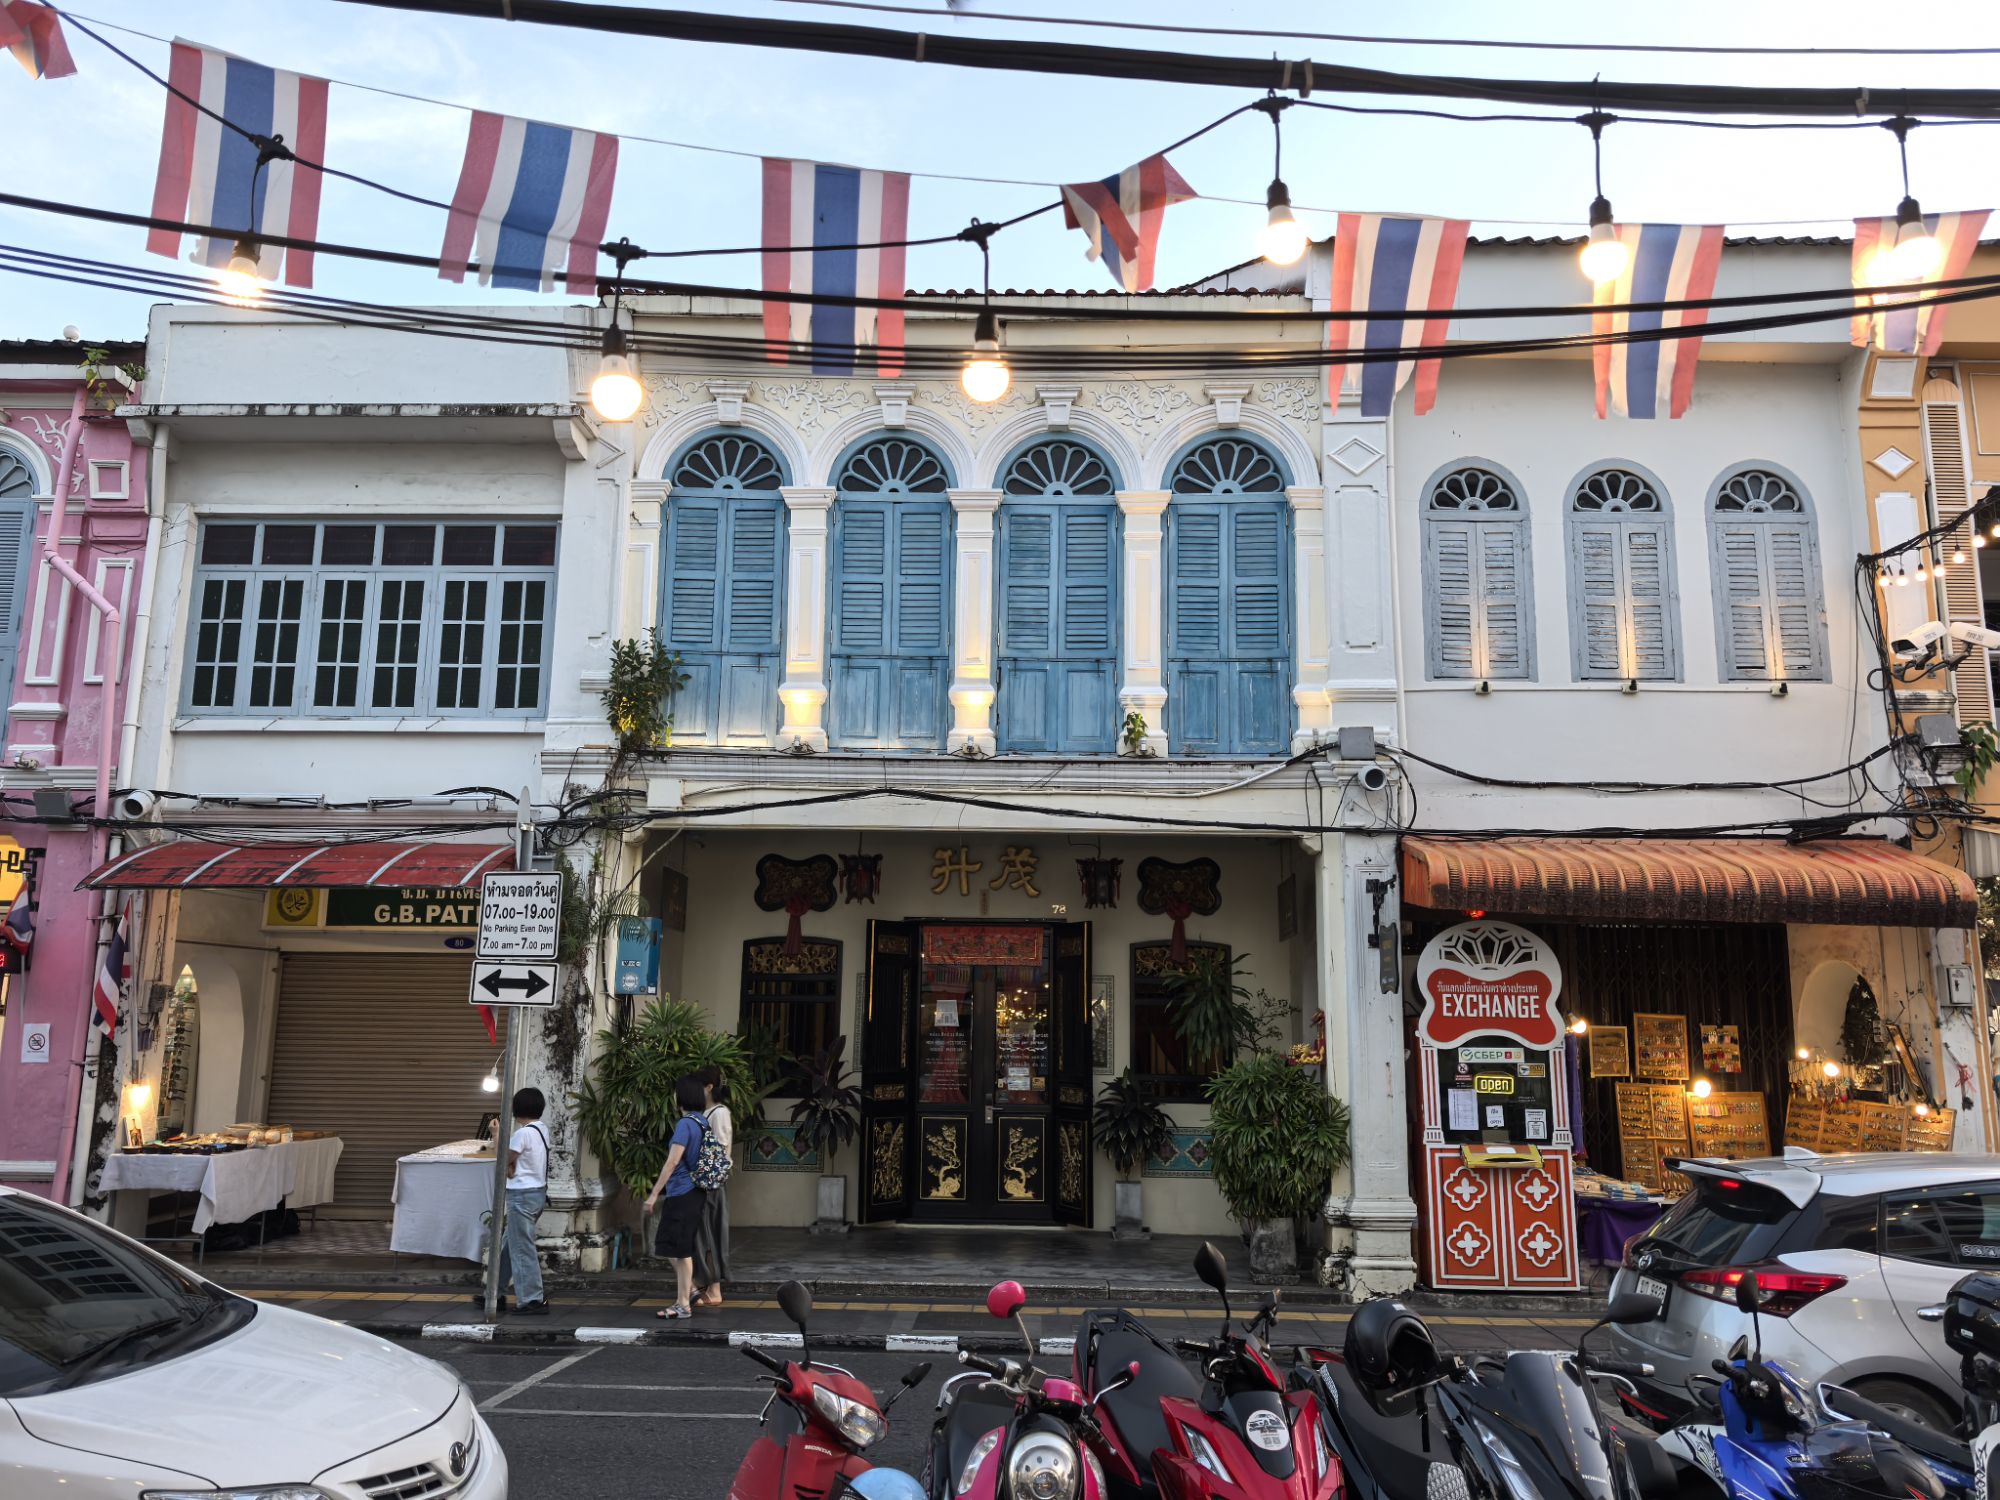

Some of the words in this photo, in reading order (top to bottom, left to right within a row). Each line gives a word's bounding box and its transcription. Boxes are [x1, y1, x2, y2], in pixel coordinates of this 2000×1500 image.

[486, 880, 558, 904] ห้ามจอดวันคู่
[374, 904, 422, 924] G.B.
[425, 905, 480, 924] PAT
[484, 903, 556, 919] 07.00-19.00
[1051, 904, 1067, 914] 78
[483, 924, 492, 933] No
[494, 924, 518, 934] Parking
[520, 924, 536, 933] Even
[538, 924, 554, 934] Days
[482, 937, 499, 950] 7.00
[540, 942, 553, 951] pm
[1441, 993, 1541, 1019] EXCHANGE
[1473, 1050, 1503, 1060] СБЕР
[1479, 1079, 1509, 1093] open
[804, 1444, 832, 1456] HONDA
